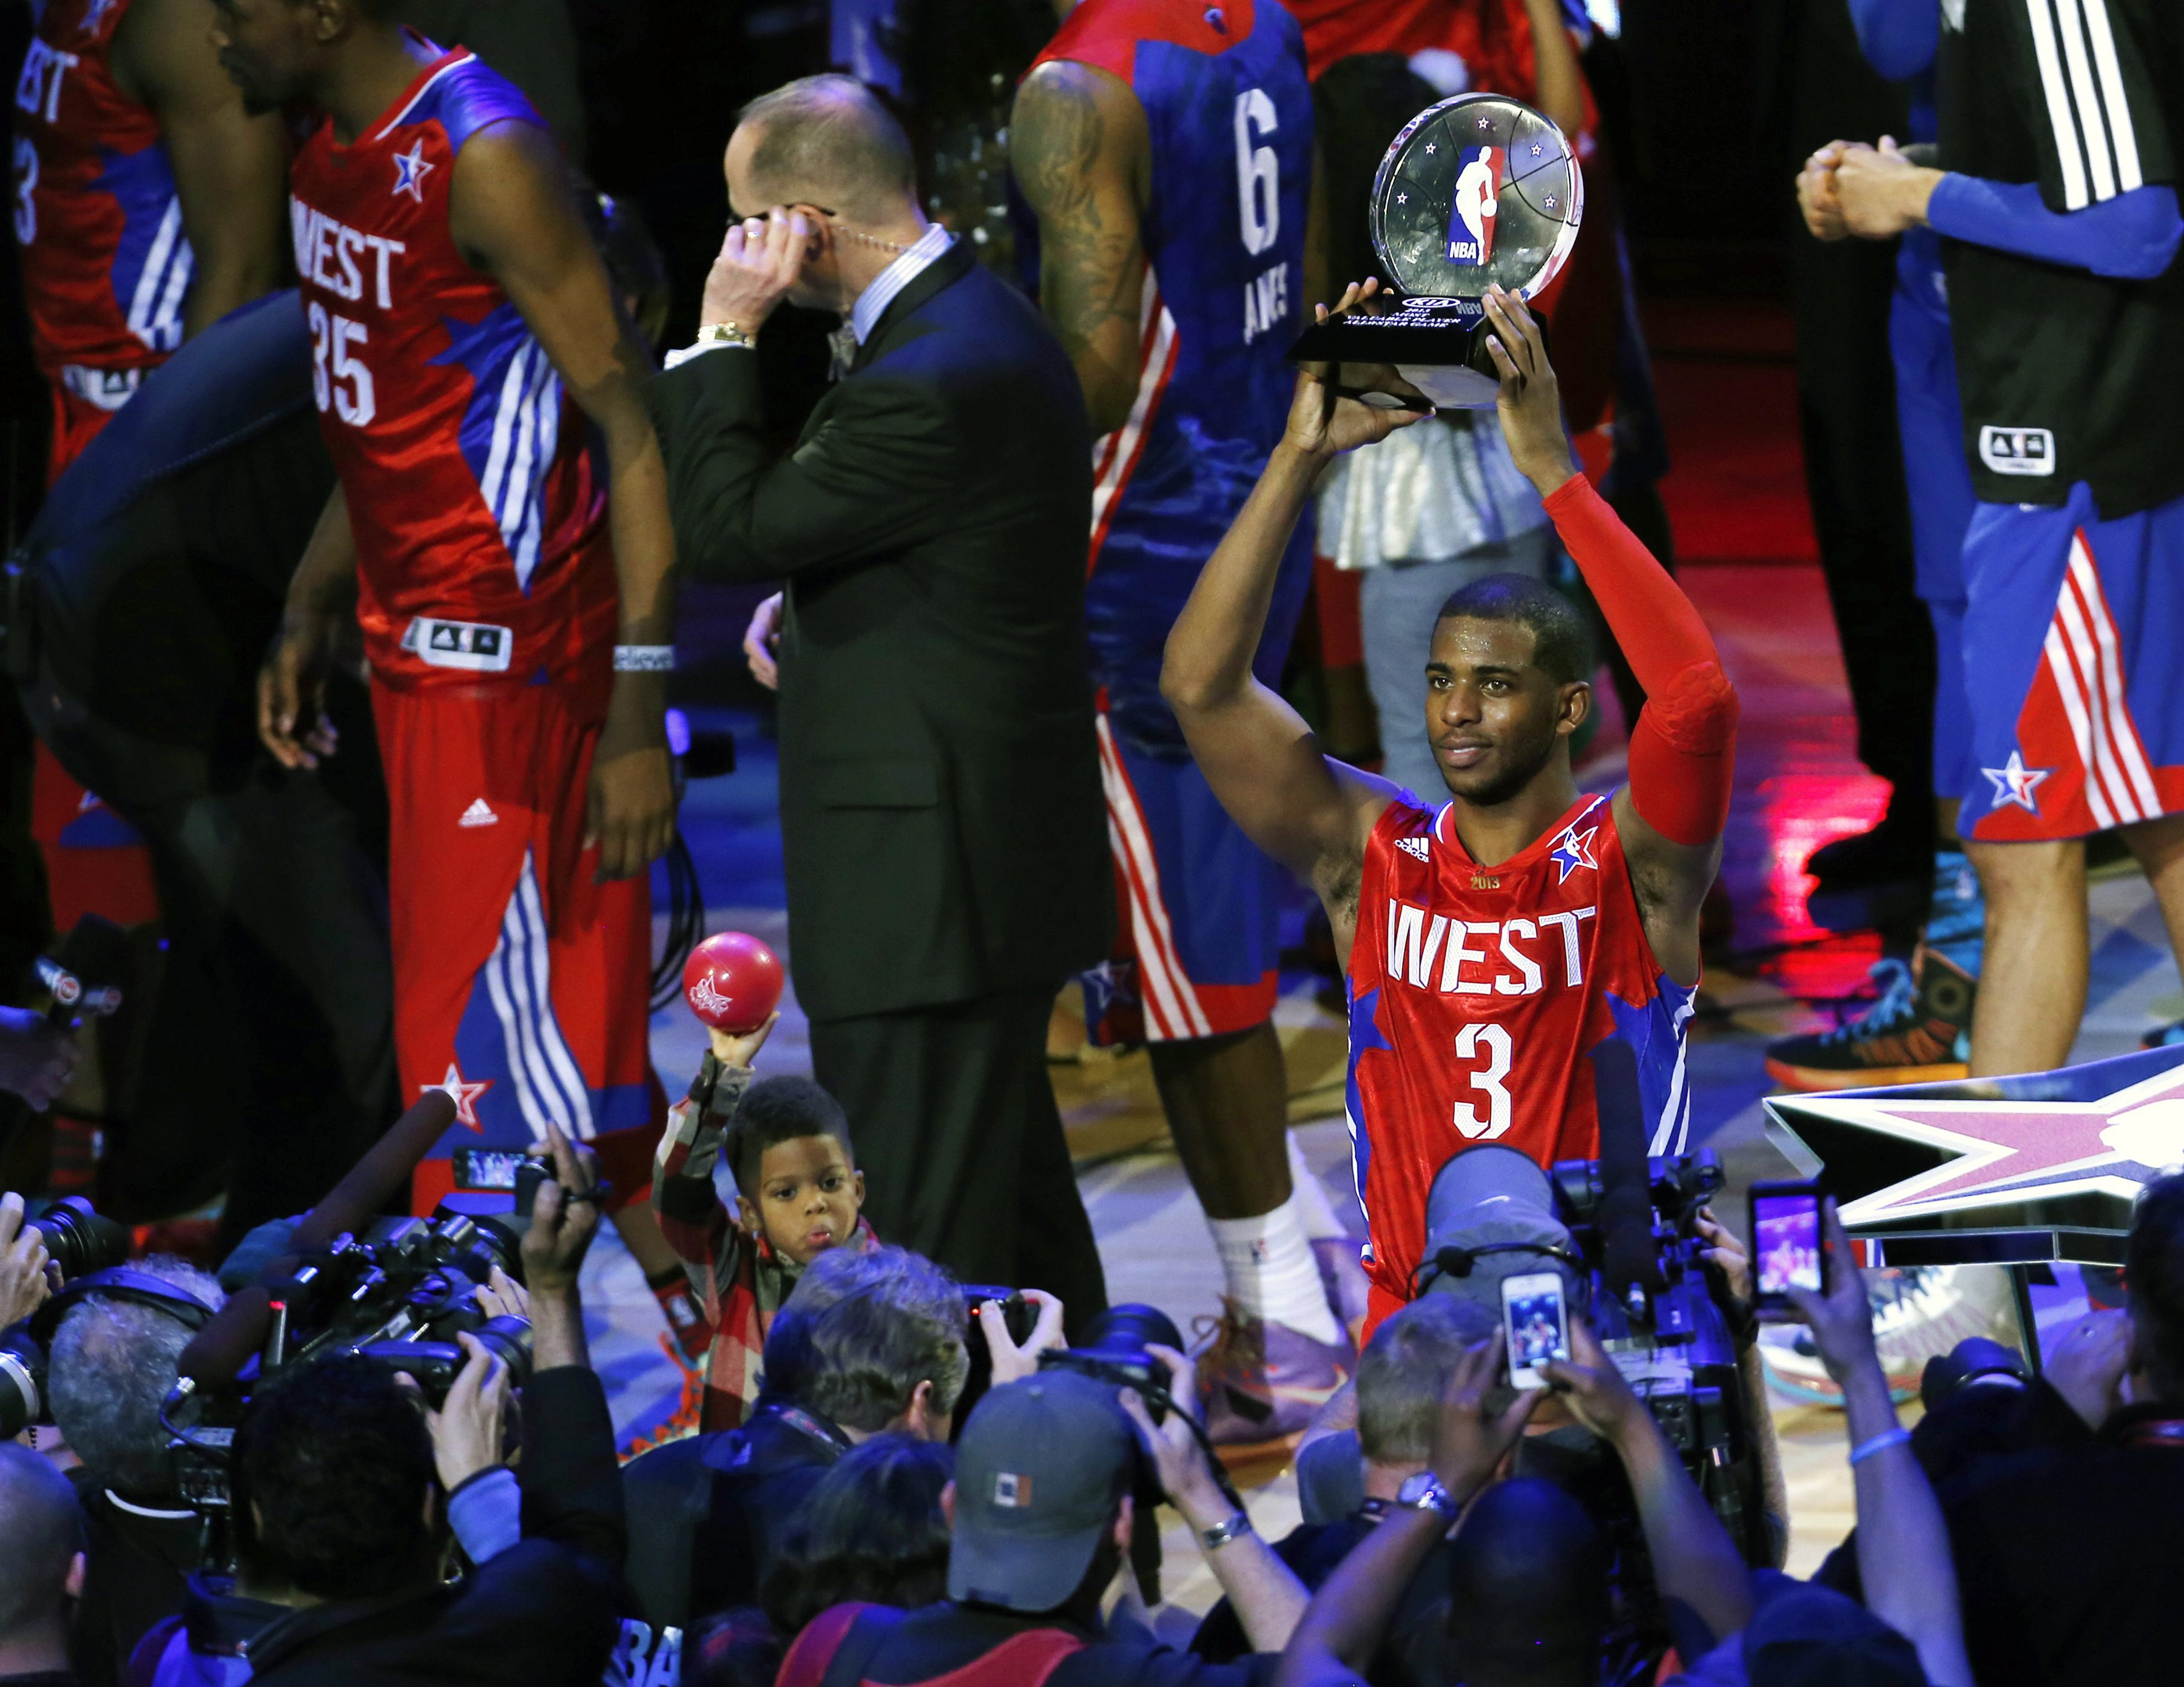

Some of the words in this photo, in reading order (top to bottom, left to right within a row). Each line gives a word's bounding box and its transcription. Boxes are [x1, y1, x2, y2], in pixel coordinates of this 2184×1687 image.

[1234, 88, 1279, 256] 6
[289, 194, 406, 309] WEST
[1449, 241, 1477, 259] NBA
[1409, 298, 1450, 306] KIA
[308, 301, 376, 427] 35
[1394, 840, 1429, 863] adidas
[1471, 877, 1500, 889] 2013
[1387, 898, 1596, 995] WEST
[1454, 1023, 1512, 1140] 3
